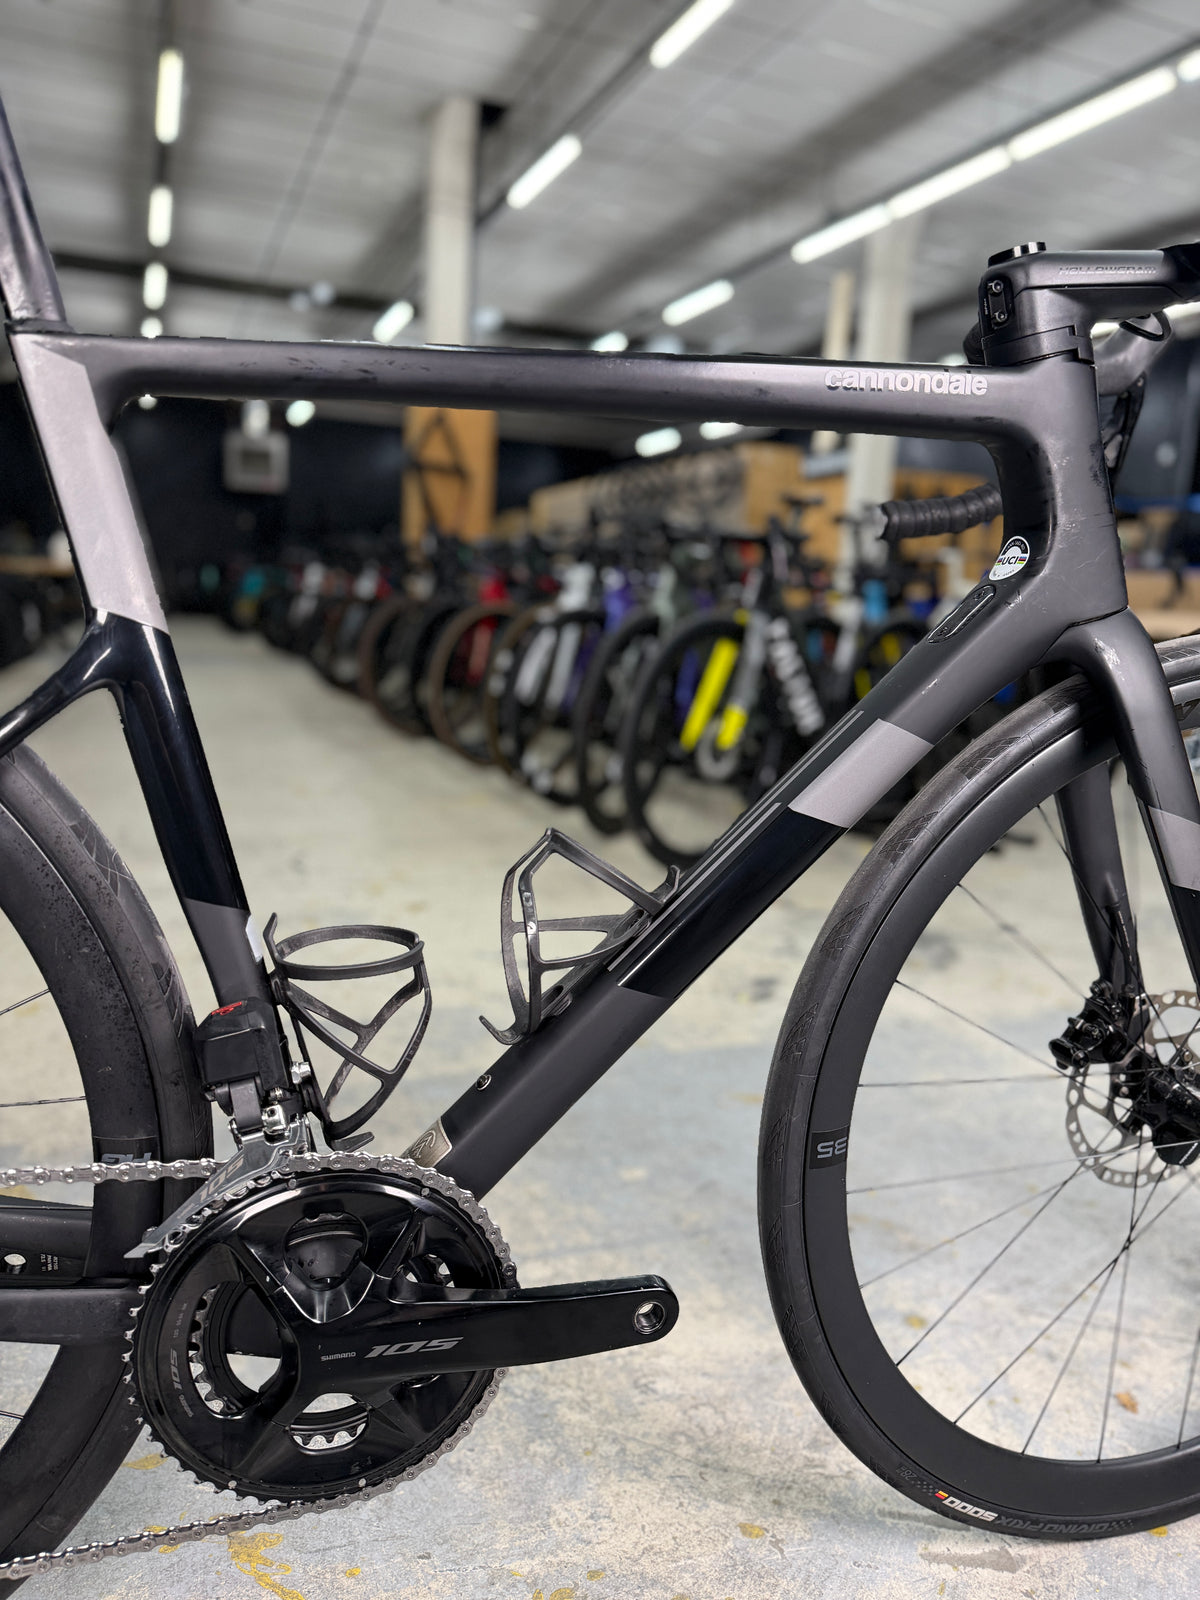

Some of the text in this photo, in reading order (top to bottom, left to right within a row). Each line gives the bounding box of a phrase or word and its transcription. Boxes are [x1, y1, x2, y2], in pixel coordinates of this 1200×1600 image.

[824, 368, 988, 396] cannondale
[1001, 555, 1019, 566] UCI
[816, 1136, 848, 1159] 35
[320, 1336, 465, 1362] SHIMANO 105
[169, 1348, 183, 1391] 105
[943, 1497, 999, 1523] 5000
